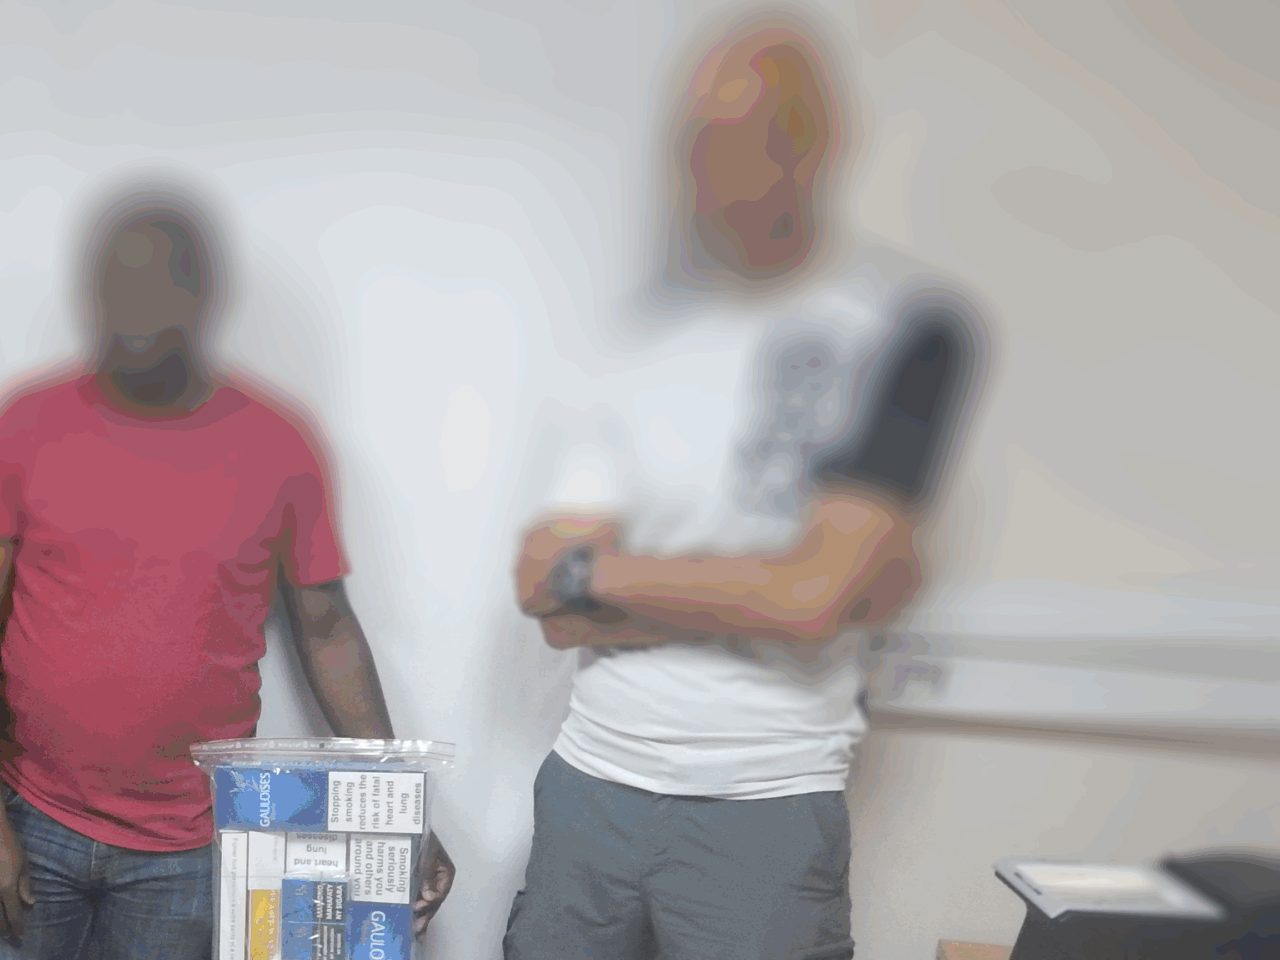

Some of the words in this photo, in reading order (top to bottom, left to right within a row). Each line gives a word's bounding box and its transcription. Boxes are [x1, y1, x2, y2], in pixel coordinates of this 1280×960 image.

[358, 774, 367, 786] the
[372, 776, 380, 797] fatal
[385, 780, 394, 799] and
[259, 772, 271, 828] GAULOISES
[330, 780, 341, 823] Stopping
[345, 782, 355, 823] smoking
[358, 786, 367, 830] reduces
[372, 800, 380, 810] of
[399, 793, 410, 815] lung
[412, 782, 422, 825] diseases
[372, 811, 381, 829] risk
[385, 801, 394, 826] heart
[296, 833, 338, 842] diseases
[306, 844, 327, 854] lung
[354, 838, 363, 875] around
[365, 840, 374, 860] and
[376, 841, 386, 874] harms
[294, 858, 312, 866] and
[314, 858, 339, 868] heart
[385, 846, 397, 893] seriously
[397, 847, 409, 893] Smoking
[353, 877, 362, 897] you
[365, 862, 374, 895] others
[374, 877, 384, 896] you
[336, 910, 342, 920] NY
